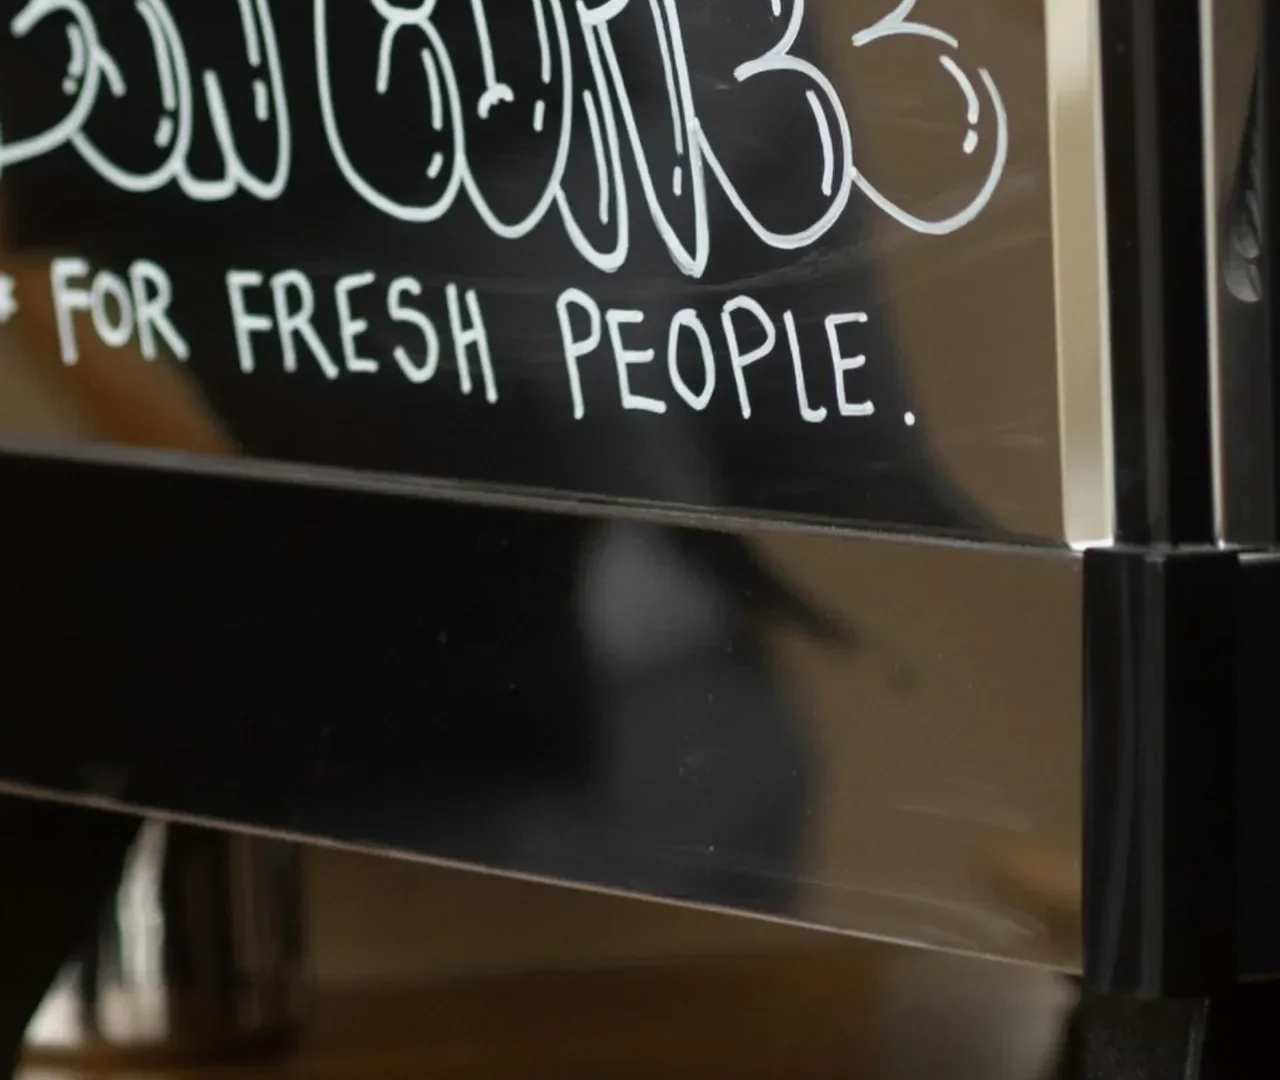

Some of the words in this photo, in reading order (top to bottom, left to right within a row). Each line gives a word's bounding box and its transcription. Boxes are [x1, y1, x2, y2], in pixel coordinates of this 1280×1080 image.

[50, 256, 191, 367] FOR
[226, 268, 499, 404] FRESH
[555, 286, 916, 427] PEOPLE.
